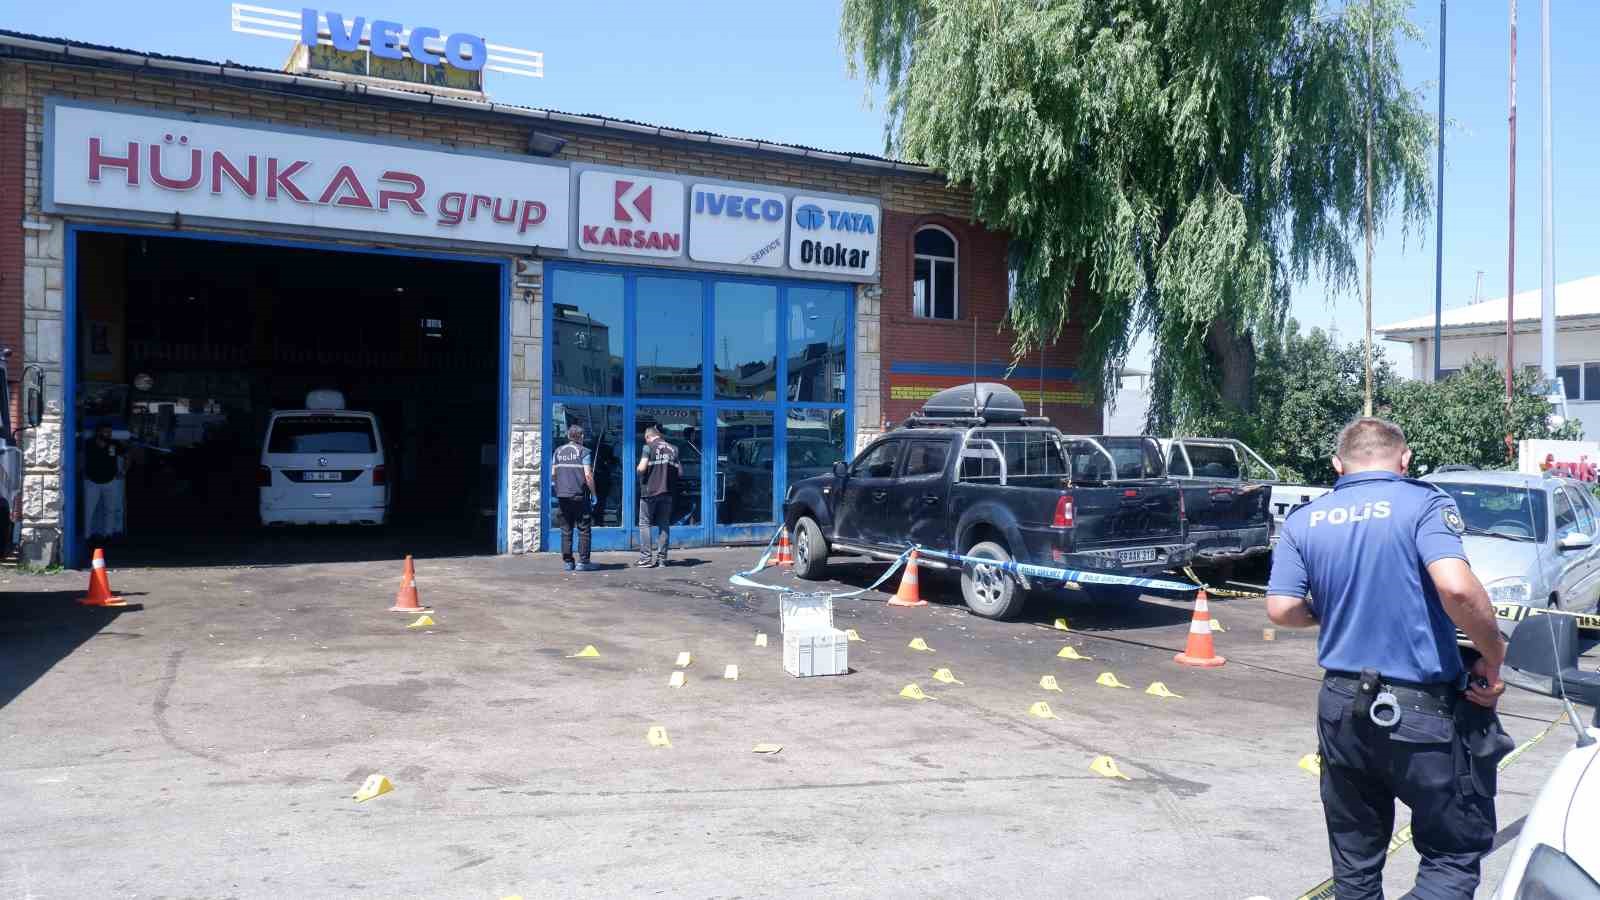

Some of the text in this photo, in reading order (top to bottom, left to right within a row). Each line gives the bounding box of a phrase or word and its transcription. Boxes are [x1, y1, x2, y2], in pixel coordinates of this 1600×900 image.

[301, 8, 487, 72] IVECO
[88, 133, 548, 233] HÜNKAR grup
[695, 191, 784, 222] IVECO
[828, 210, 875, 235] TATA
[583, 225, 681, 252] KARSAN
[751, 238, 782, 263] SERVICE
[800, 239, 870, 269] Otokar
